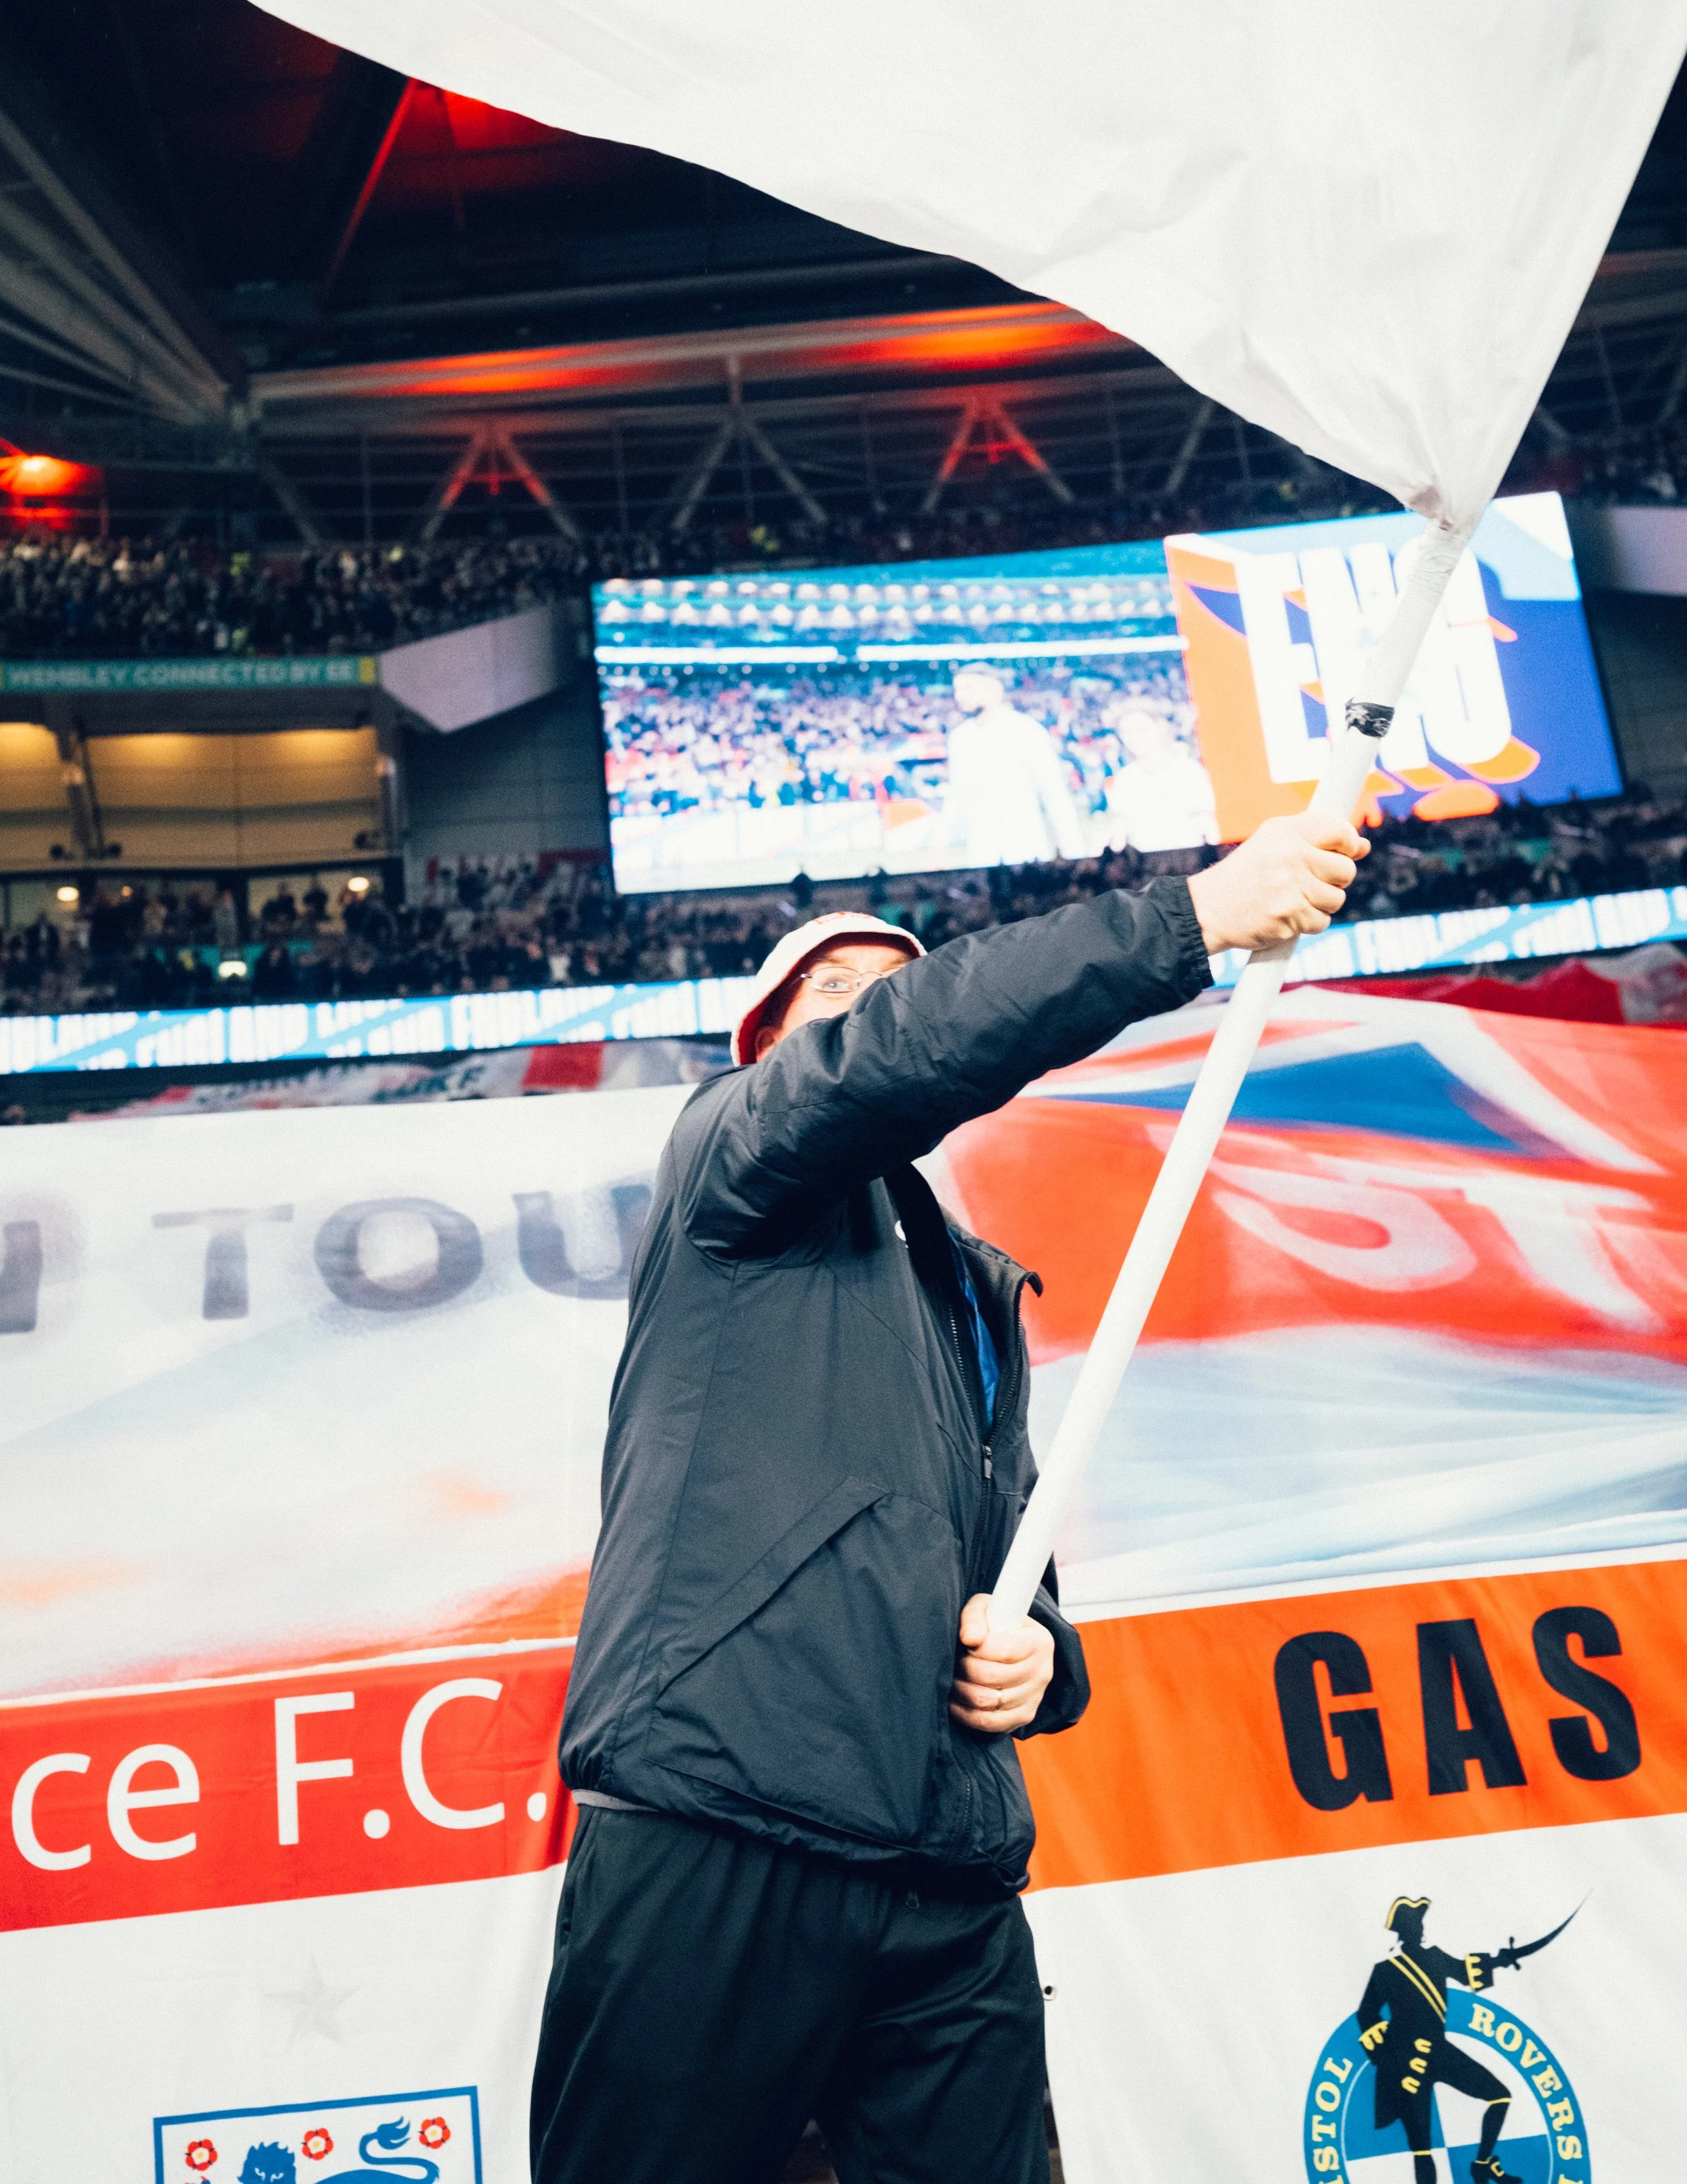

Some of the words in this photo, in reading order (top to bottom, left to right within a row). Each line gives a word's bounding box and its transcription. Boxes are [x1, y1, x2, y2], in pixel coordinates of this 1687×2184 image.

[11, 1744, 200, 1872] ce
[274, 1678, 547, 1847] F.C.
[1274, 1606, 1642, 1812] GAS
[1468, 2002, 1584, 2162] ROVERS
